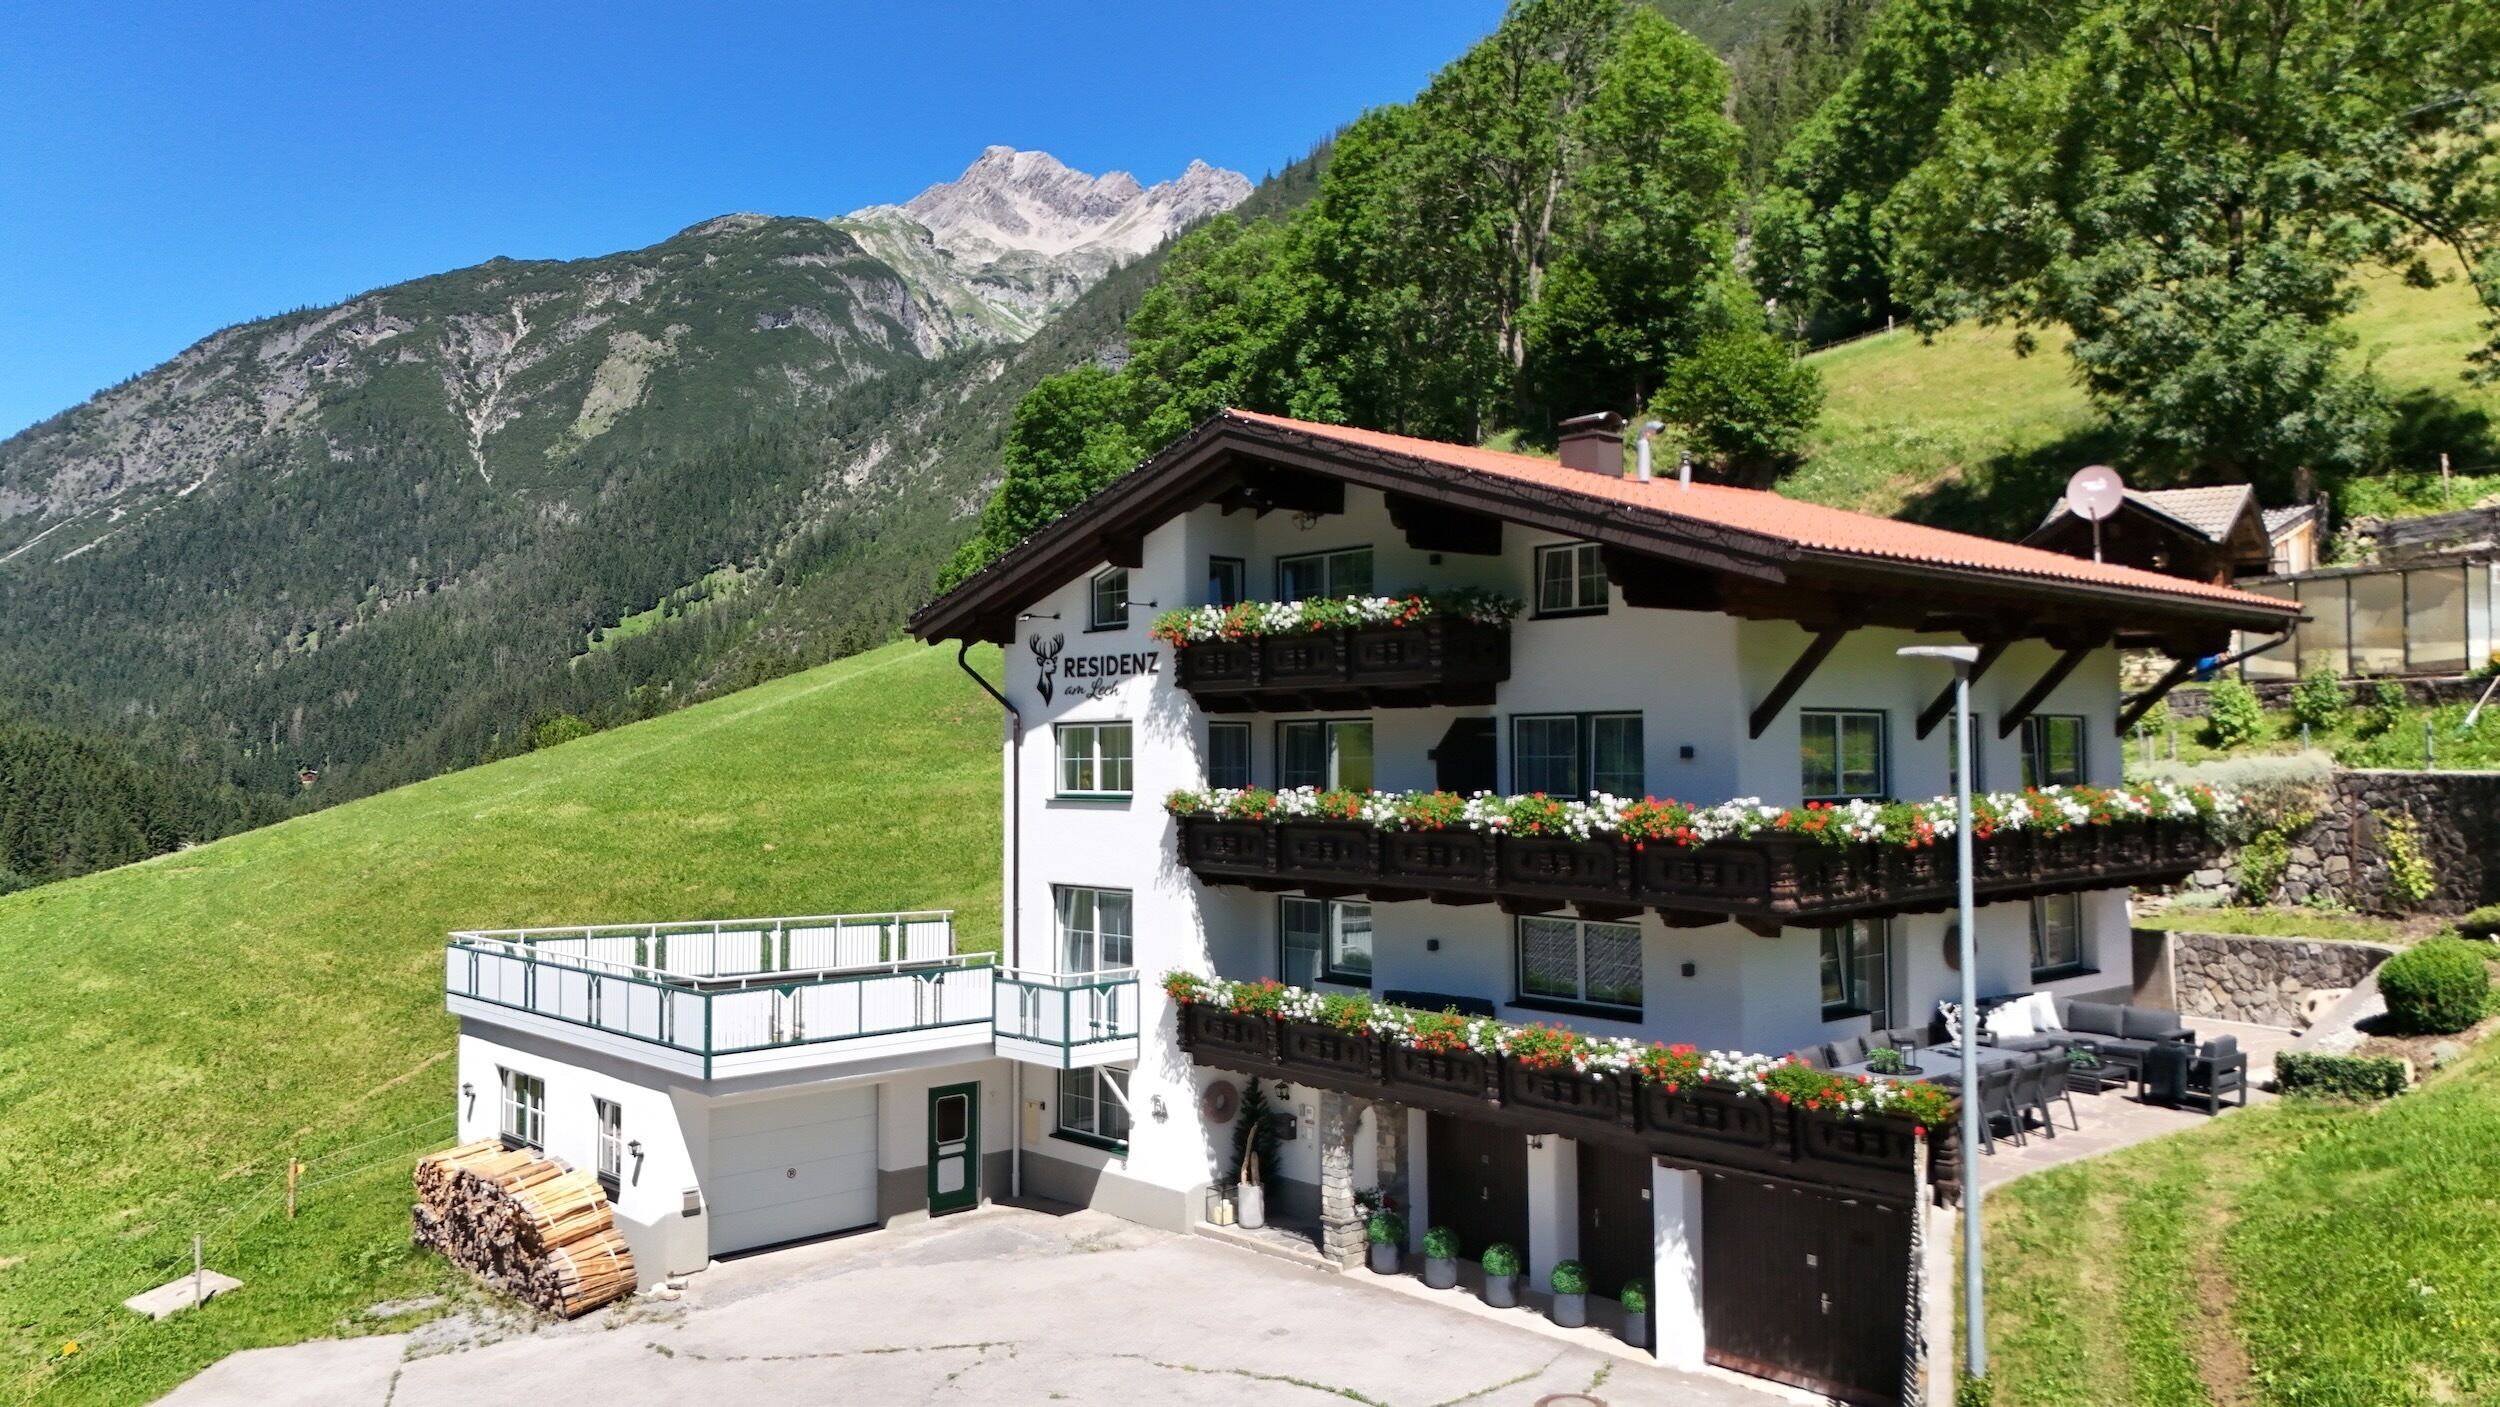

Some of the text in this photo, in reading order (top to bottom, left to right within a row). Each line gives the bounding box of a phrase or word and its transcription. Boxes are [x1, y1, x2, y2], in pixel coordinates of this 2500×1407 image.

[1064, 651, 1159, 678] RESIDENZ
[1064, 677, 1120, 701] am Lech
